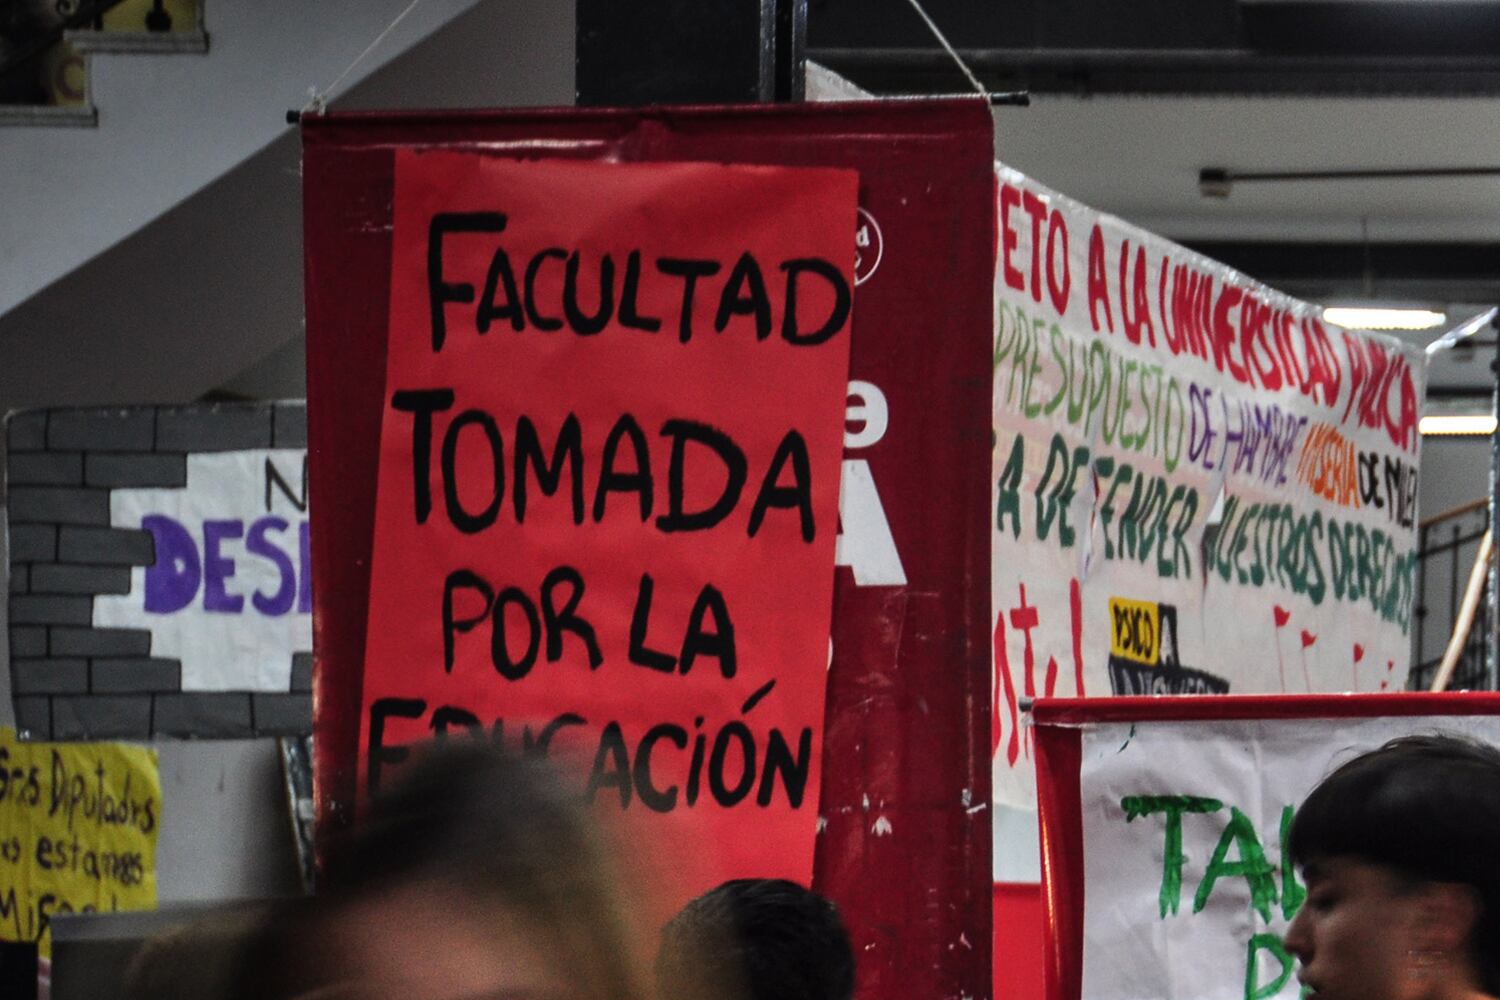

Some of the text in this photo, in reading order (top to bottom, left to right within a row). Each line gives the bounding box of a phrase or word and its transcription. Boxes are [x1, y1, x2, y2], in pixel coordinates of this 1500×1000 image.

[427, 211, 852, 352] FACULTAD
[994, 174, 1071, 316] ETO
[1088, 223, 1114, 334] A
[1119, 238, 1156, 349] LA
[391, 388, 816, 543] TOMADA
[441, 566, 738, 682] POR LA
